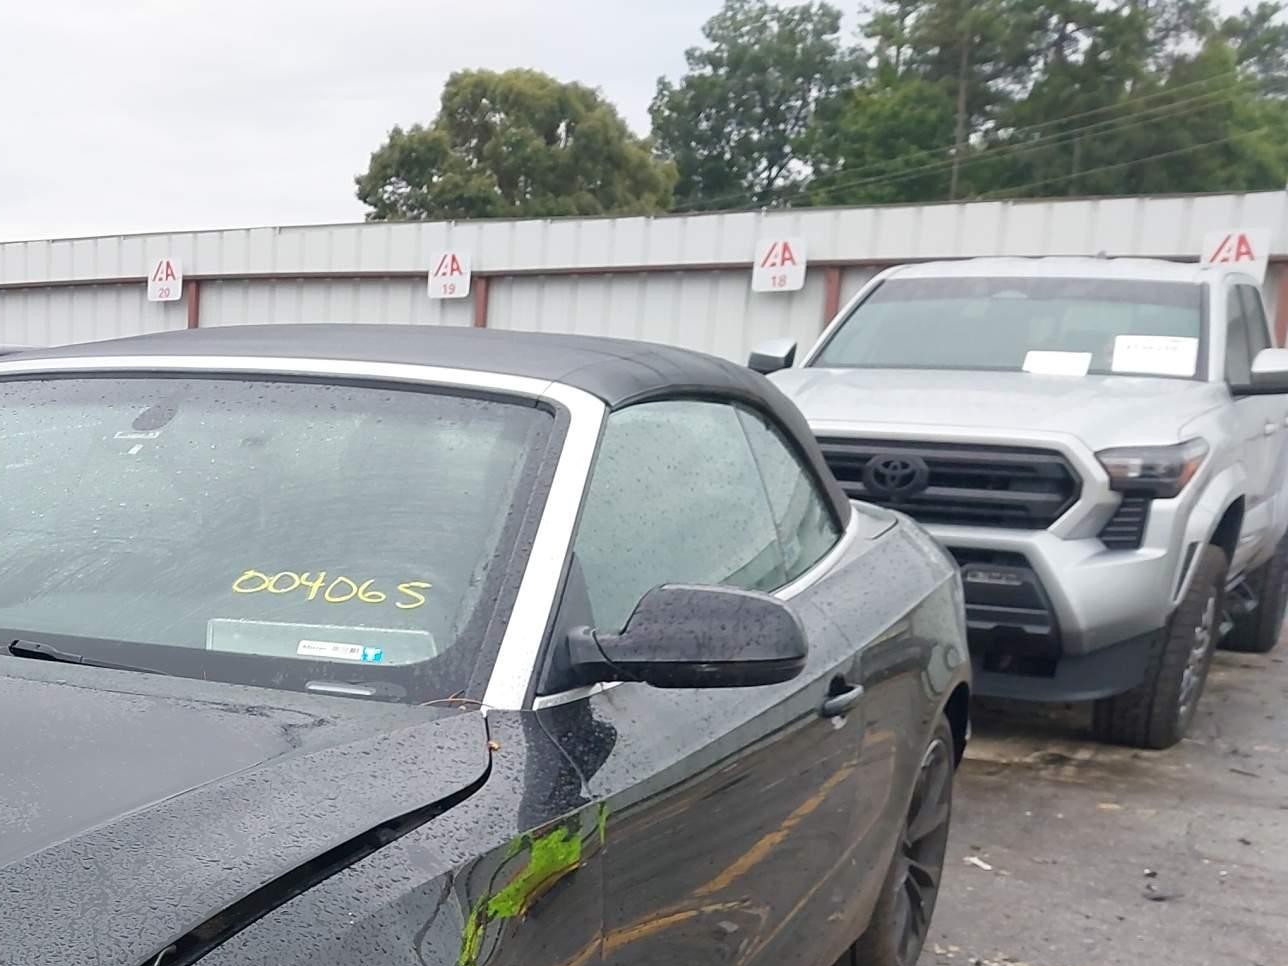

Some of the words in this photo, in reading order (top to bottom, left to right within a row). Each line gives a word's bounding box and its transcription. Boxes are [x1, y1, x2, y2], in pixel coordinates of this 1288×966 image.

[771, 275, 787, 288] 18
[158, 288, 171, 298] 20
[442, 284, 456, 295] 19
[232, 570, 433, 609] 004065
